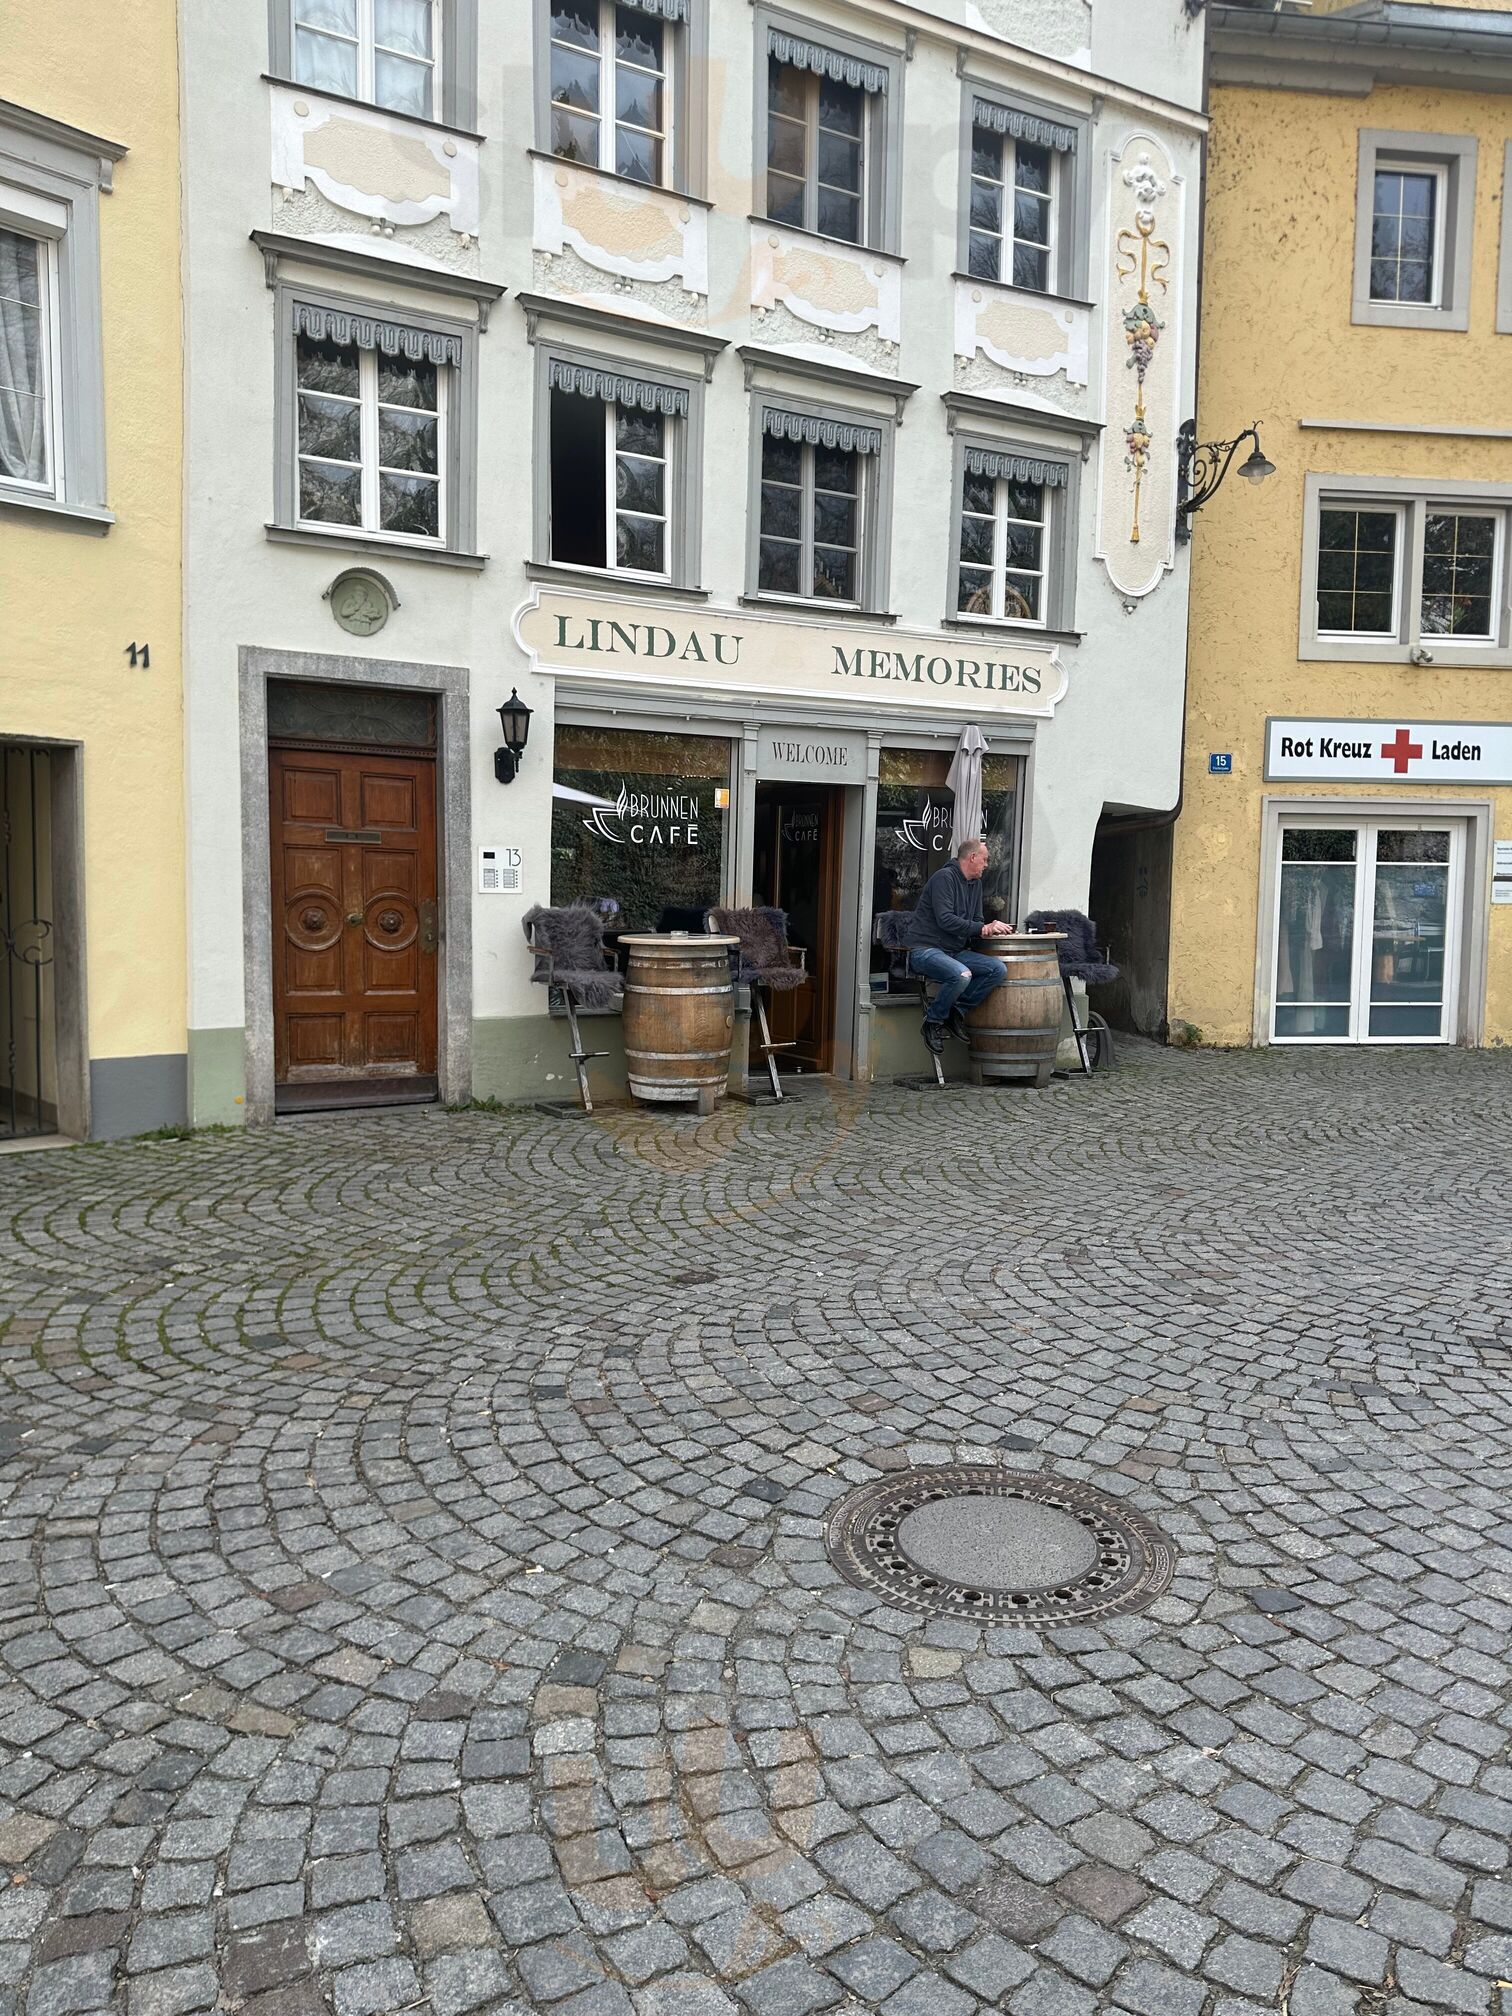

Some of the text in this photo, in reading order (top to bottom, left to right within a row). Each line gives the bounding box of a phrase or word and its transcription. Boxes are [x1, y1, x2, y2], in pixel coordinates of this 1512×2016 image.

[125, 641, 150, 669] 11
[553, 613, 1042, 694] LINDAU MEMORIES
[771, 741, 849, 767] WELCOME
[1215, 755, 1227, 767] 15
[1281, 737, 1481, 761] Rot Kreuz Laden
[630, 793, 699, 819] BRUNNEN
[505, 848, 522, 867] 13
